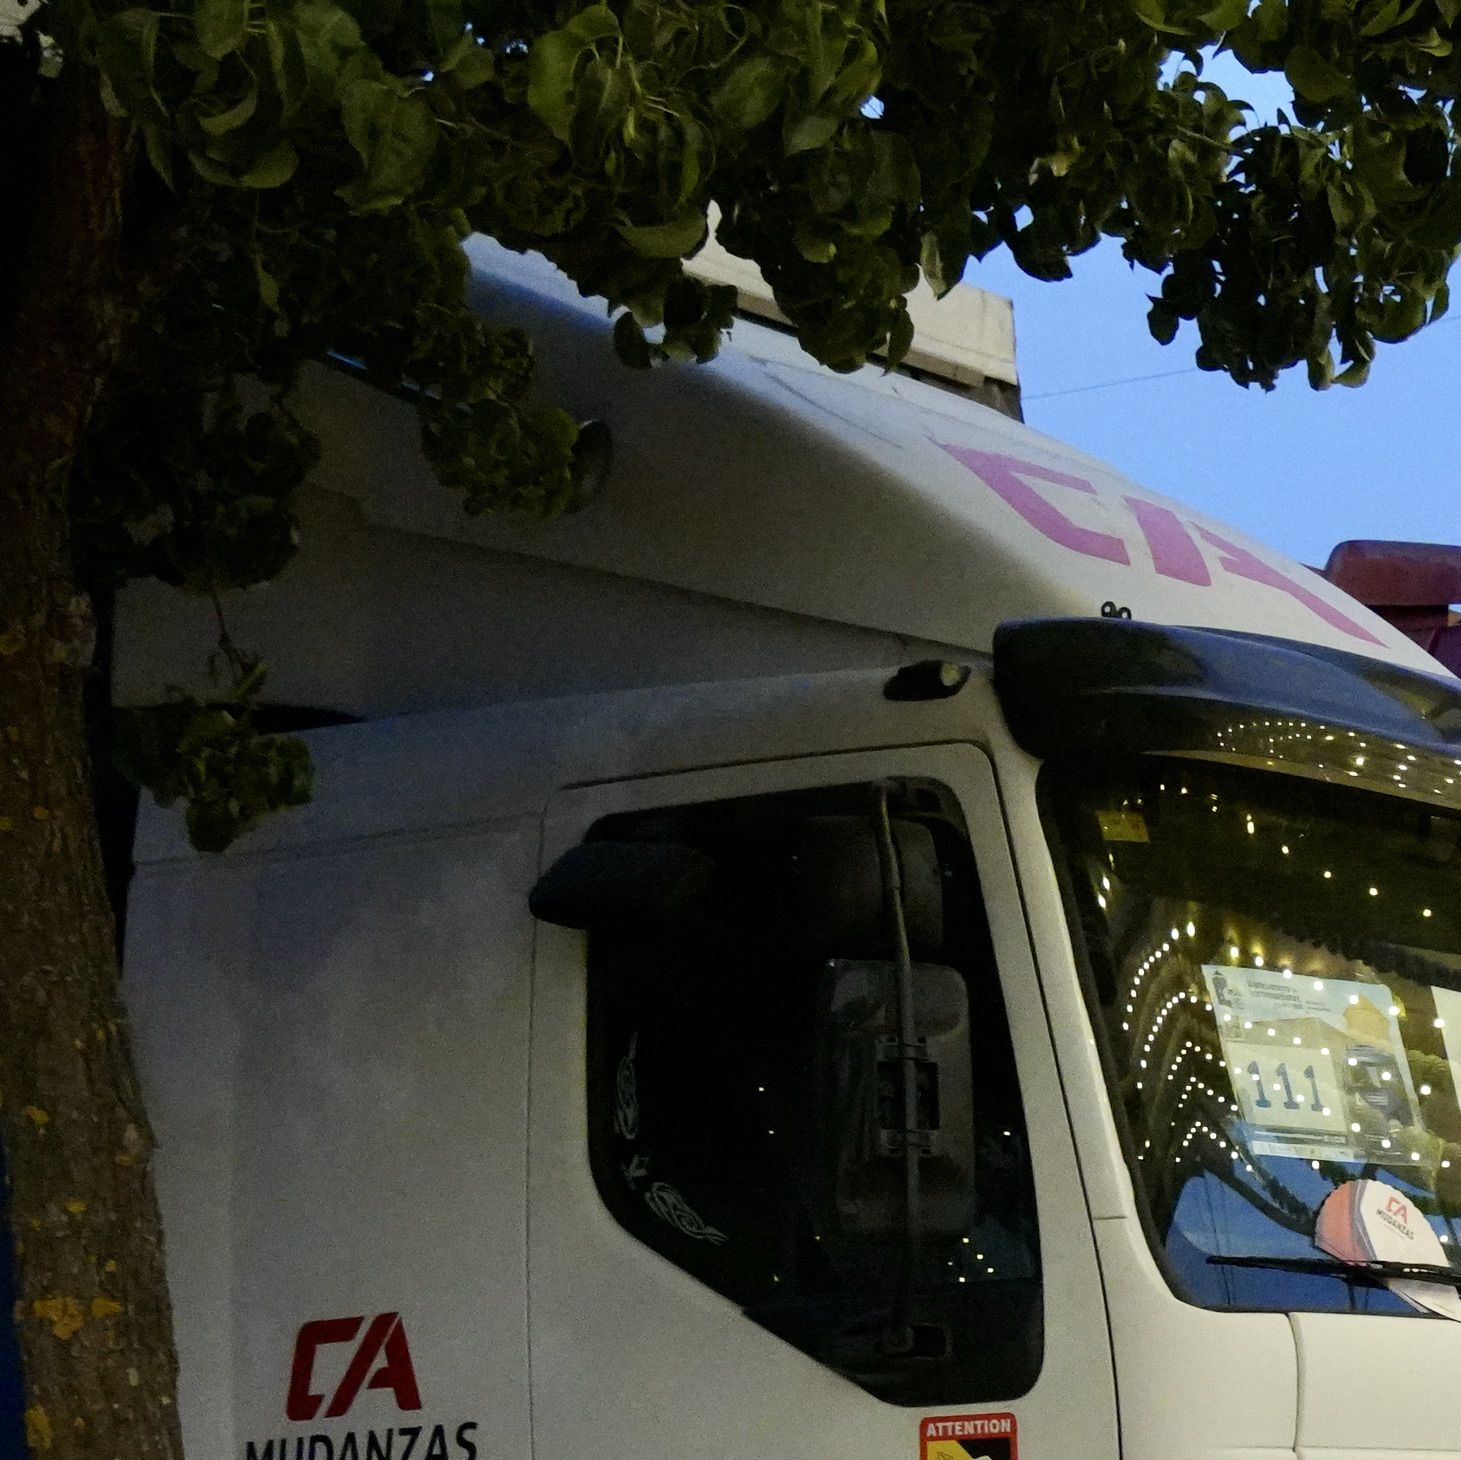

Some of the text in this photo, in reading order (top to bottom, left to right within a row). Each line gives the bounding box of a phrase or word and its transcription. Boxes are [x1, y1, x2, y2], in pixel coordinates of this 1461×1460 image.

[1247, 1060, 1325, 1112] 111
[1385, 1196, 1408, 1225] CA
[286, 1312, 422, 1422] CA
[927, 1419, 1011, 1437] ATTENTION
